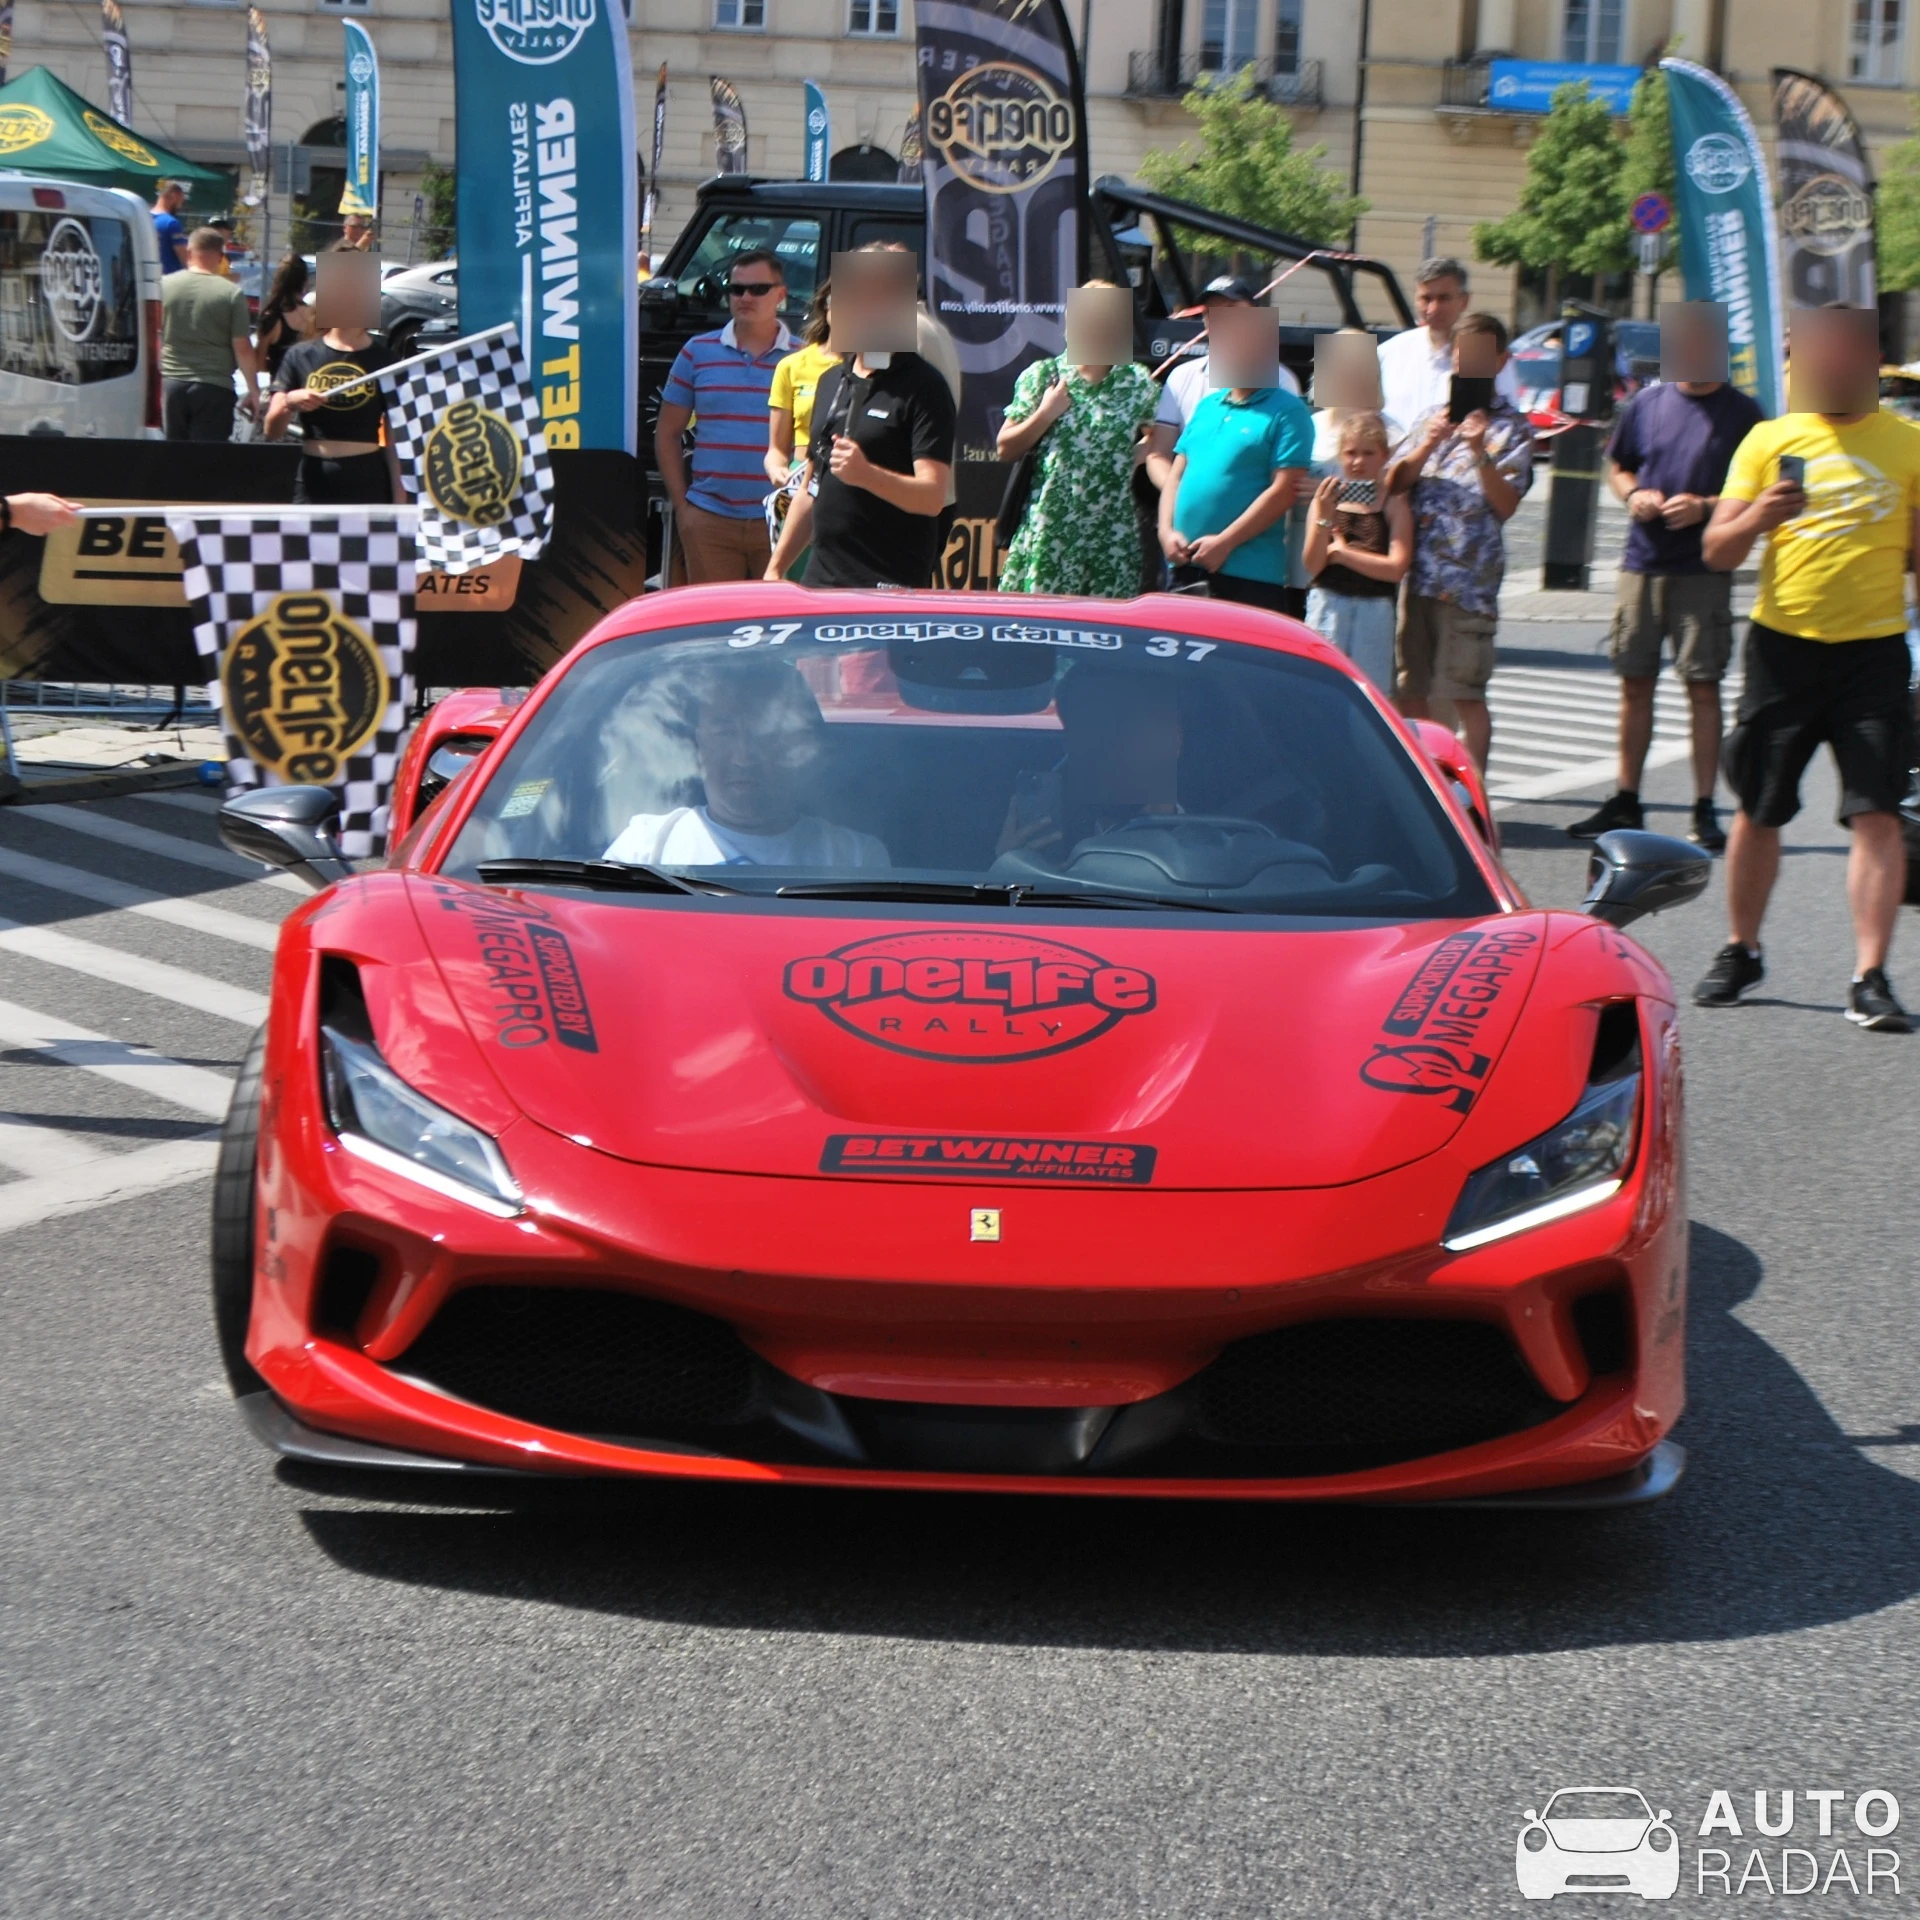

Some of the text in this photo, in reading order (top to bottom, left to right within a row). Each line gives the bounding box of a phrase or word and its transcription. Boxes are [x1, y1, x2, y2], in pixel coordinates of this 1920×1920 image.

[1569, 323, 1592, 351] P
[430, 444, 456, 508] RALLY
[727, 623, 803, 648] 37
[1145, 636, 1218, 662] 37
[239, 644, 267, 744] RALLY
[470, 913, 550, 1048] MEGAPRO
[534, 934, 585, 1013] SUPPORTED
[1392, 950, 1459, 1021] SUPPORTED
[1422, 931, 1538, 1048] MEGAPRO
[879, 1016, 1062, 1037] RALLY
[1016, 1162, 1133, 1179] AFFILIATES
